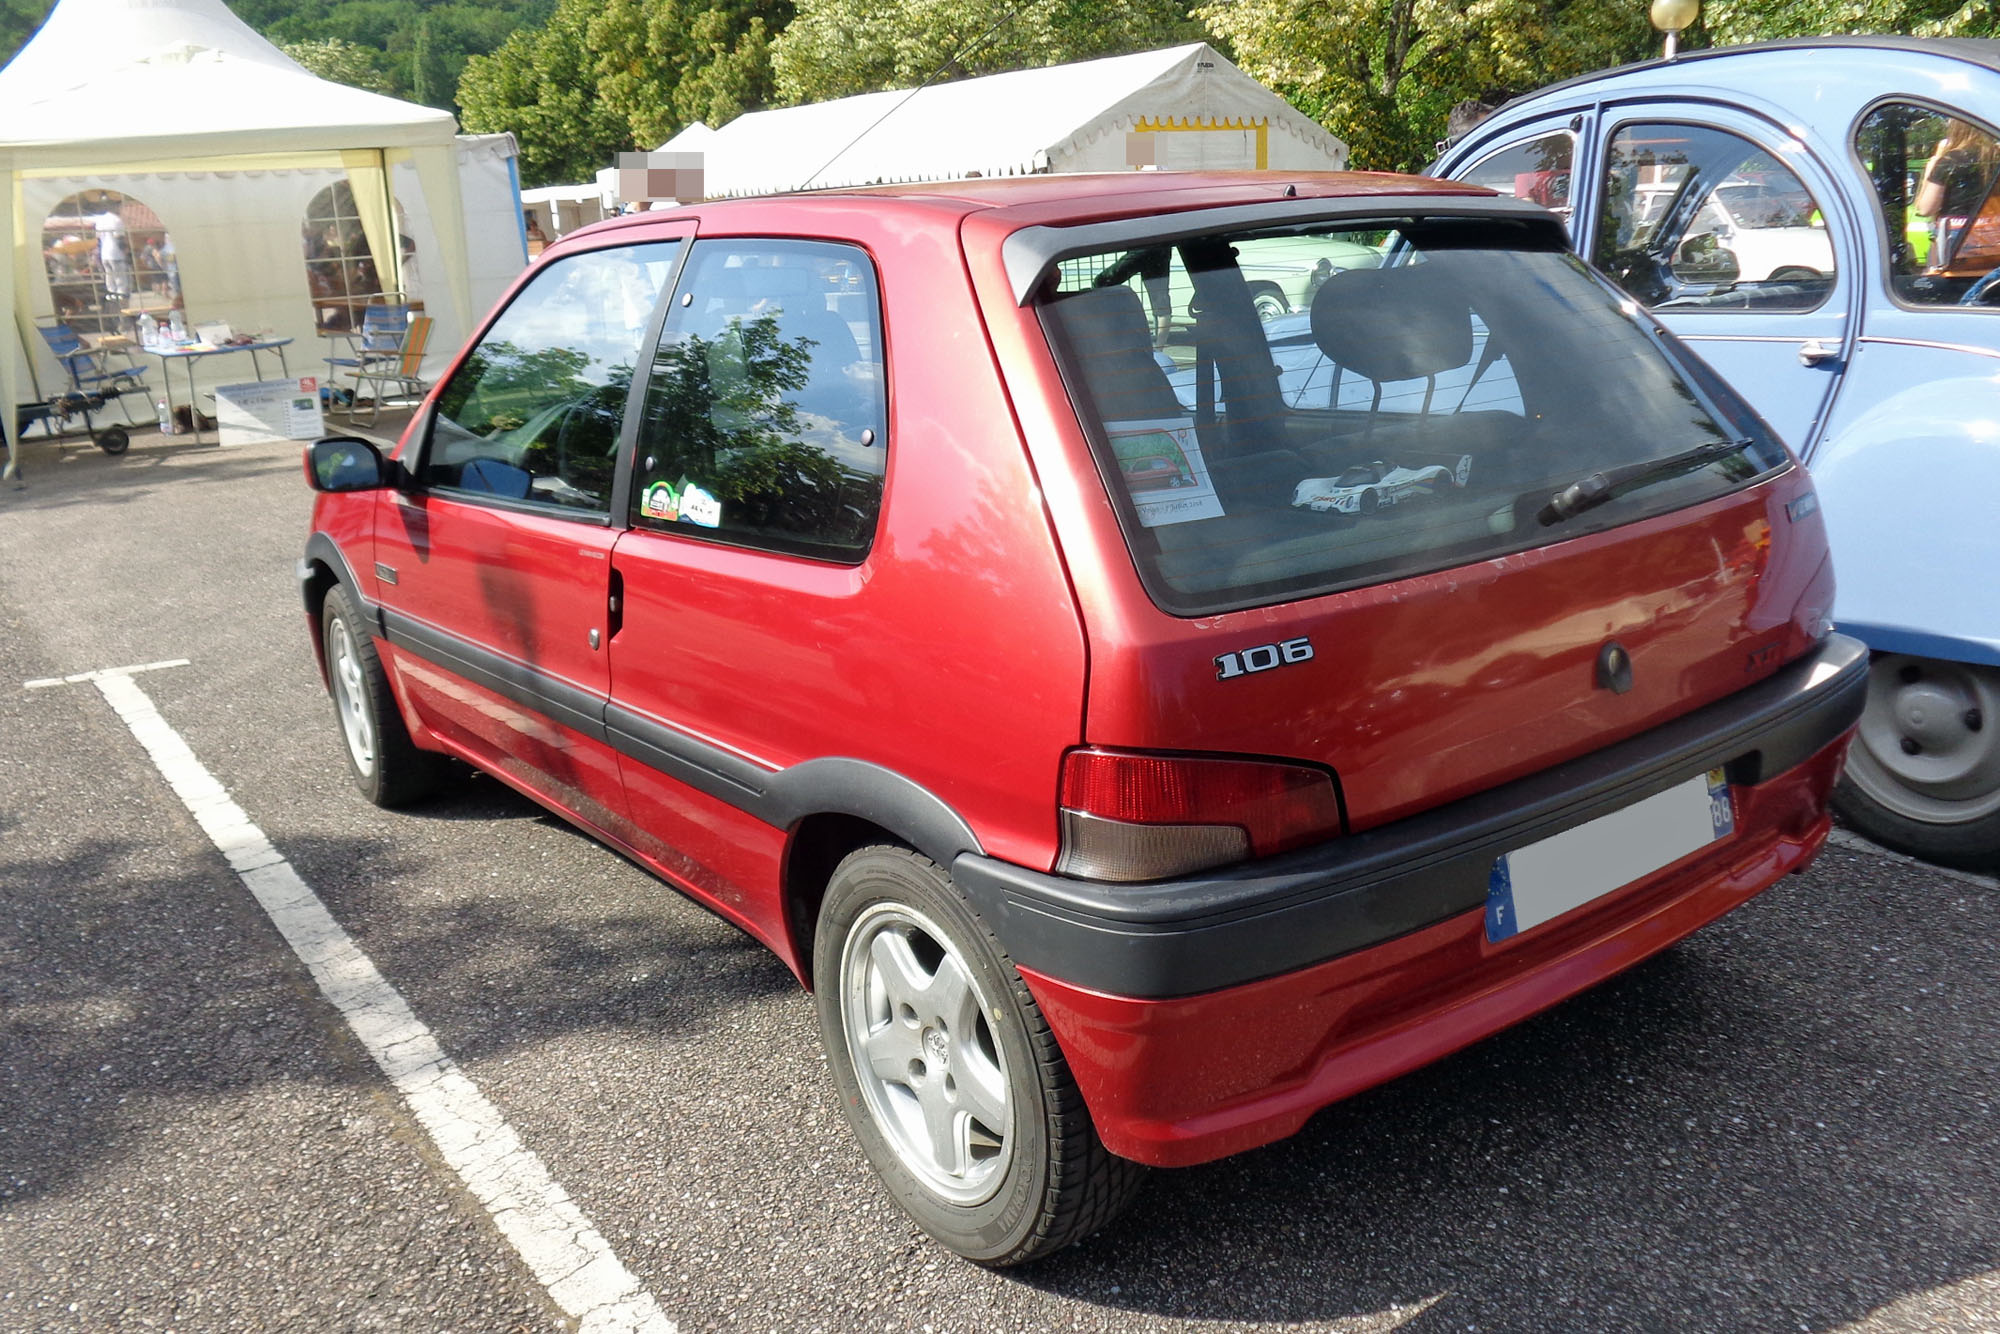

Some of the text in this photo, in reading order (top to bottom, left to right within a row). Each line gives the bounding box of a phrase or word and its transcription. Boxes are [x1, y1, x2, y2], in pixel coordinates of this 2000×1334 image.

[1213, 636, 1315, 681] 106
[1712, 796, 1731, 827] 88
[1495, 905, 1505, 926] F
